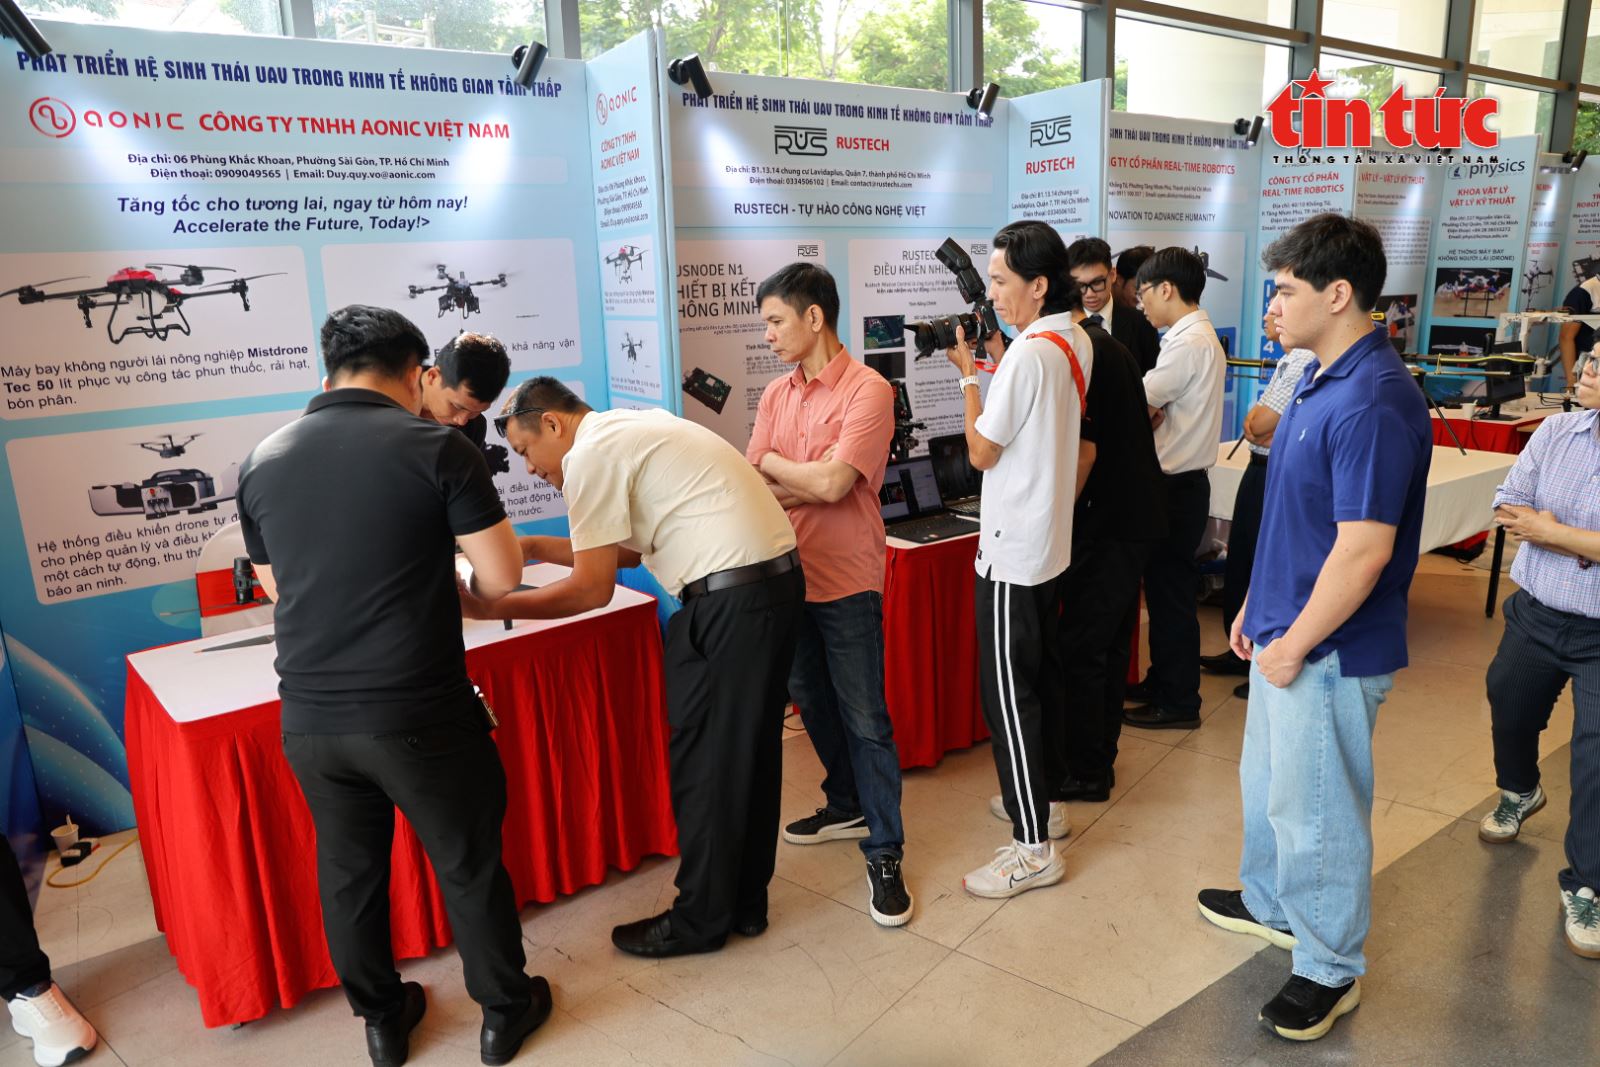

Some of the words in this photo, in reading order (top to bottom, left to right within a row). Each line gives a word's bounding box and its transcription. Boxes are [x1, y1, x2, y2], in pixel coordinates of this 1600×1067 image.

[73, 49, 129, 77] TRIỂN
[134, 56, 159, 82] HỆ
[164, 60, 207, 80] SINH
[211, 61, 250, 83] THÁI
[255, 66, 287, 84] UAV
[292, 67, 344, 87] TRONG
[349, 71, 384, 90] KINH
[389, 68, 405, 91] TẾ
[410, 73, 457, 93] KHÔNG
[462, 78, 494, 95] GIAN
[713, 90, 742, 110] TRIỂN
[746, 94, 758, 114] HỆ
[762, 98, 786, 112] SINH
[789, 98, 810, 114] THÁI
[814, 102, 832, 116] UAV
[835, 104, 864, 118] TRONG
[867, 106, 888, 120] KINH
[891, 104, 900, 121] TẾ
[903, 108, 931, 124] KHÔNG
[199, 110, 263, 132] CÔNG
[267, 116, 292, 133] TY
[297, 117, 355, 135] TNHH
[361, 120, 421, 137] AONIC
[424, 119, 463, 142] VIỆT
[468, 122, 510, 138] NAM
[836, 136, 890, 152] RUSTECH
[128, 154, 148, 165] Địa
[151, 154, 171, 164] chỉ:
[174, 154, 188, 164] 06
[191, 154, 226, 166] Phùng
[229, 154, 255, 165] Khắc
[258, 156, 294, 166] Khoan,
[296, 156, 336, 166] Phường
[339, 157, 352, 165] Sài
[355, 157, 378, 166] Gòn,
[380, 158, 392, 166] TP.
[410, 157, 424, 166] Chí
[427, 158, 449, 166] Minh
[1026, 156, 1075, 174] RUSTECH
[150, 168, 177, 180] Điện
[180, 169, 212, 180] thoại:
[214, 170, 281, 178] 0909049565
[294, 170, 324, 178] Email:
[327, 170, 435, 180] Duy.quy.vo@aonic.com
[781, 168, 800, 176] chung
[868, 170, 886, 178] thành
[1202, 163, 1235, 174] ROBOTICS
[1304, 184, 1344, 194] ROBOTICS
[1458, 188, 1480, 196] KHOA
[117, 197, 165, 215] Tăng
[172, 194, 200, 212] tốc
[206, 197, 239, 211] cho
[246, 198, 298, 214] tương
[304, 196, 327, 212] lai,
[334, 198, 372, 213] ngay
[376, 196, 395, 210] từ
[400, 196, 432, 209] hôm
[437, 196, 468, 211] nay!
[734, 203, 788, 214] RUSTECH
[798, 203, 814, 217] TỰ
[816, 202, 840, 215] HÀO
[842, 202, 872, 216] CÔNG
[876, 205, 902, 218] NGHỆ
[905, 206, 926, 218] VIỆT
[1144, 212, 1152, 220] TO
[1154, 212, 1184, 220] ADVANCE
[1185, 214, 1216, 222] HUMANITY
[173, 218, 268, 234] Accelerate
[274, 218, 300, 230] the
[306, 217, 364, 232] Future,
[728, 264, 744, 275] N1
[874, 262, 896, 276] ĐIỀU
[900, 262, 926, 275] KHIỂN
[712, 282, 726, 300] BỊ
[732, 277, 756, 296] KẾT
[724, 301, 760, 316] MINH
[1263, 340, 1274, 353] 4
[0, 365, 31, 378] Máy
[35, 364, 60, 376] bay
[64, 360, 106, 372] không
[110, 358, 148, 370] người
[152, 354, 166, 366] lái
[170, 354, 200, 364] nông
[204, 349, 244, 364] nghiệp
[248, 346, 308, 358] Mistdrone
[4, 382, 31, 394] Tec
[37, 380, 54, 390] 50
[60, 378, 72, 388] lít
[78, 376, 110, 390] phục
[115, 375, 130, 384] vụ
[136, 372, 167, 382] công
[172, 370, 191, 380] tác
[196, 367, 226, 380] phun
[230, 361, 266, 374] thuốc,
[270, 360, 285, 370] rải
[8, 397, 34, 410] bón
[39, 394, 77, 409] phân.
[37, 541, 57, 552] Hệ
[62, 534, 100, 549] thống
[105, 529, 132, 542] điều
[137, 523, 170, 537] khiển
[176, 520, 209, 532] drone
[214, 517, 226, 526] tự
[41, 557, 65, 568] cho
[70, 550, 102, 565] phép
[106, 544, 137, 558] quản
[140, 541, 150, 553] lý
[156, 538, 169, 548] và
[174, 533, 198, 546] điều
[44, 571, 70, 582] một
[74, 565, 104, 578] cách
[108, 564, 122, 572] tự
[126, 558, 160, 570] động,
[164, 552, 182, 562] thu
[46, 585, 72, 598] báo
[76, 583, 92, 592] an
[96, 576, 127, 588] ninh.
